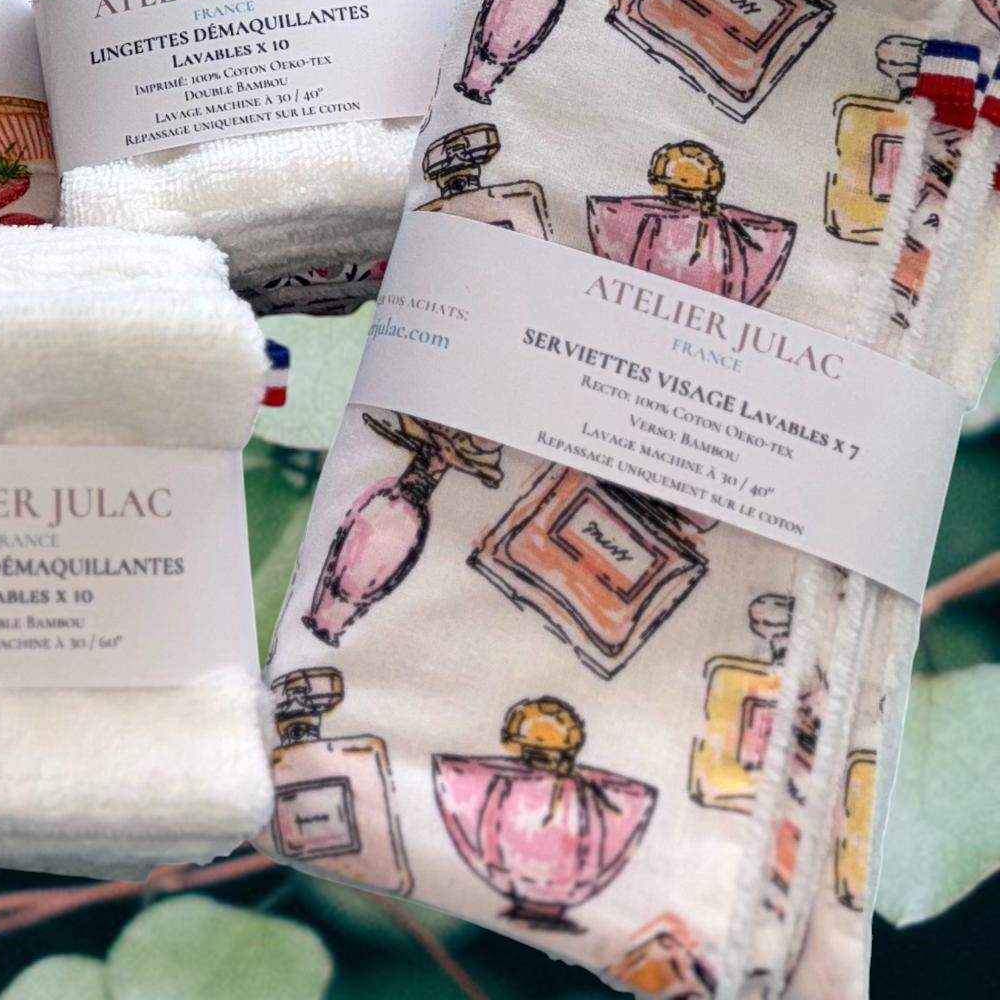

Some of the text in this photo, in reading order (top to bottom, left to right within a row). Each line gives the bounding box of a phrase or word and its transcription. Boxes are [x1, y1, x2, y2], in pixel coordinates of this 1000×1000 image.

[193, 0, 255, 21] FRANCE
[90, 4, 369, 65] LINGETTES DÉMAQUILLANTES
[172, 44, 252, 68] LAVABLES
[273, 39, 289, 52] 10
[191, 71, 221, 85] 100%
[223, 64, 267, 80] COTON
[270, 55, 333, 71] OEKO-TEX
[155, 107, 203, 124] LAVAGE
[205, 97, 261, 115] MACHINE
[294, 89, 300, 103] /
[184, 77, 288, 102] DOUBLE BAMBOU
[125, 101, 361, 147] REPASSAGE UNIQUEMENT SUR LE COTON
[584, 274, 844, 381] ATELIER JULAC
[672, 337, 743, 375] FRANCE
[522, 327, 652, 385] SERVIETTES
[657, 373, 736, 413] VISAGE
[740, 404, 830, 447] LAVABLES
[849, 444, 861, 463] 7
[635, 394, 670, 415] 100%
[673, 404, 723, 434] COTON
[581, 422, 636, 453] LAVAGE
[639, 444, 702, 477] MACHINE
[680, 431, 740, 464] BAMBOU
[537, 430, 805, 535] REPASSAGE UNIQUEMENT SUR LE COTON
[48, 487, 173, 528] JULAC
[73, 589, 94, 604] 10
[26, 616, 86, 628] BAMBOU
